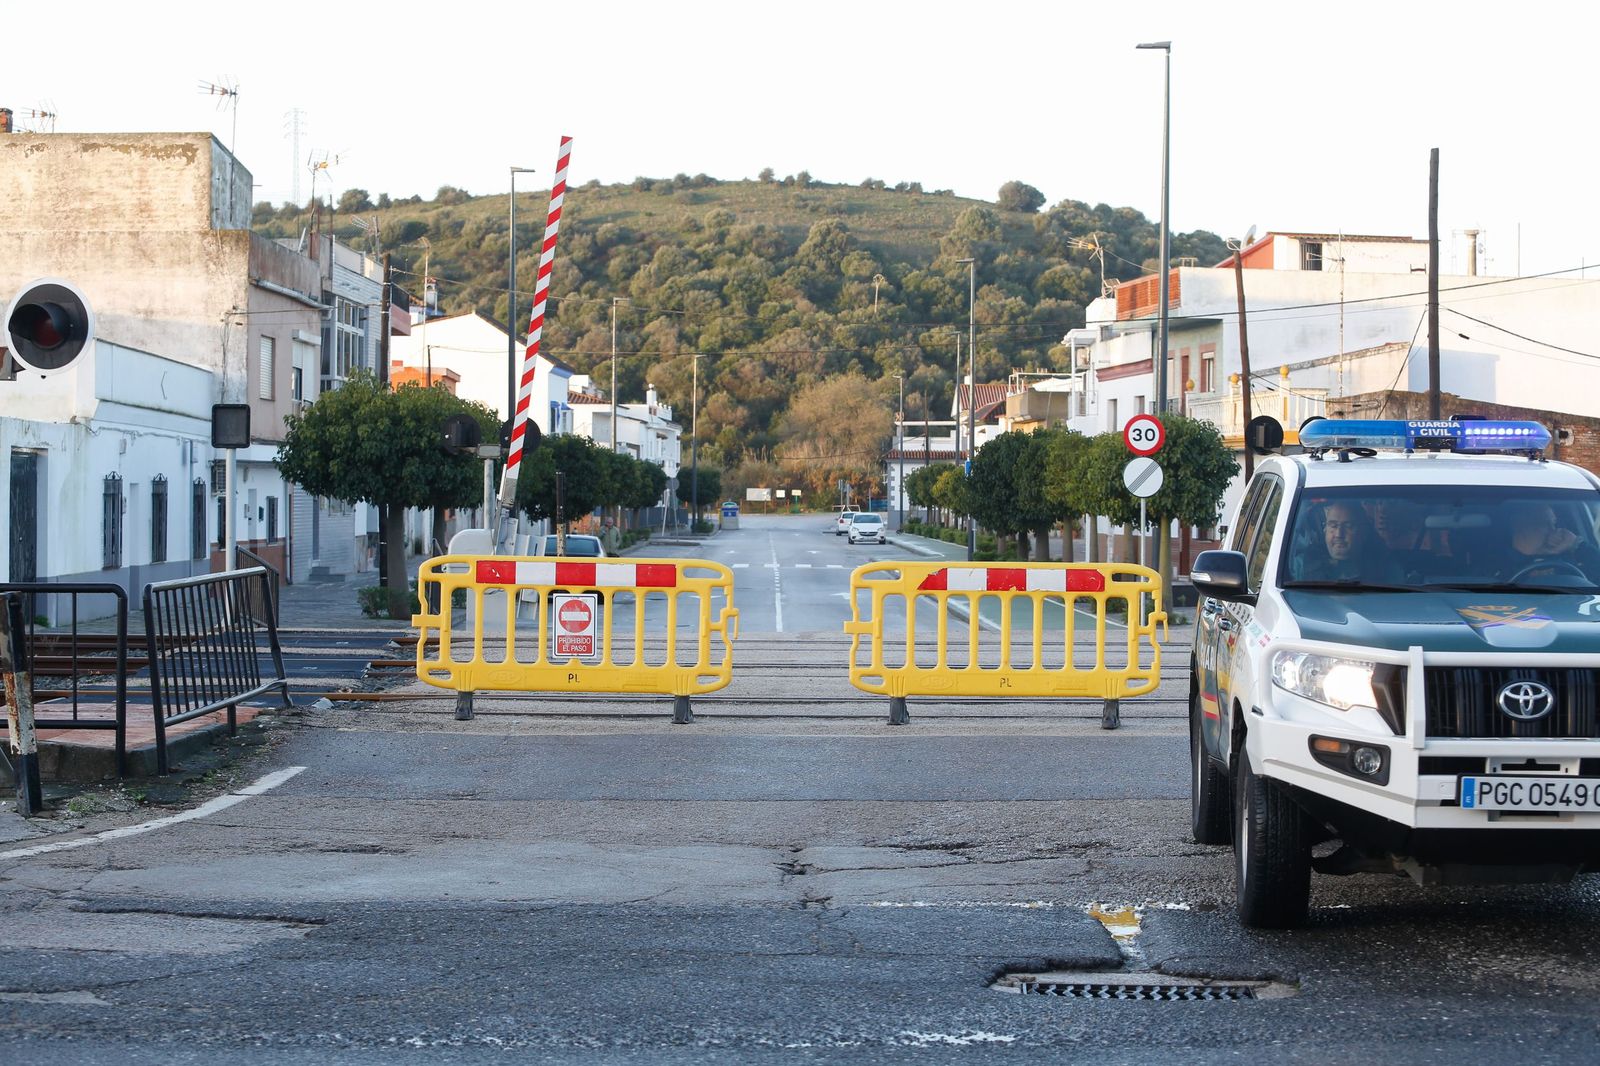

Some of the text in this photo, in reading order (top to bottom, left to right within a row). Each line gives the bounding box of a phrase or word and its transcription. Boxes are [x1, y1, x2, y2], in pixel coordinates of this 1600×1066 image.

[1132, 428, 1155, 441] 30
[1420, 428, 1451, 436] CIVIL
[1000, 677, 1012, 688] PL
[1479, 782, 1523, 805] PGC
[1529, 783, 1588, 806] 0549
